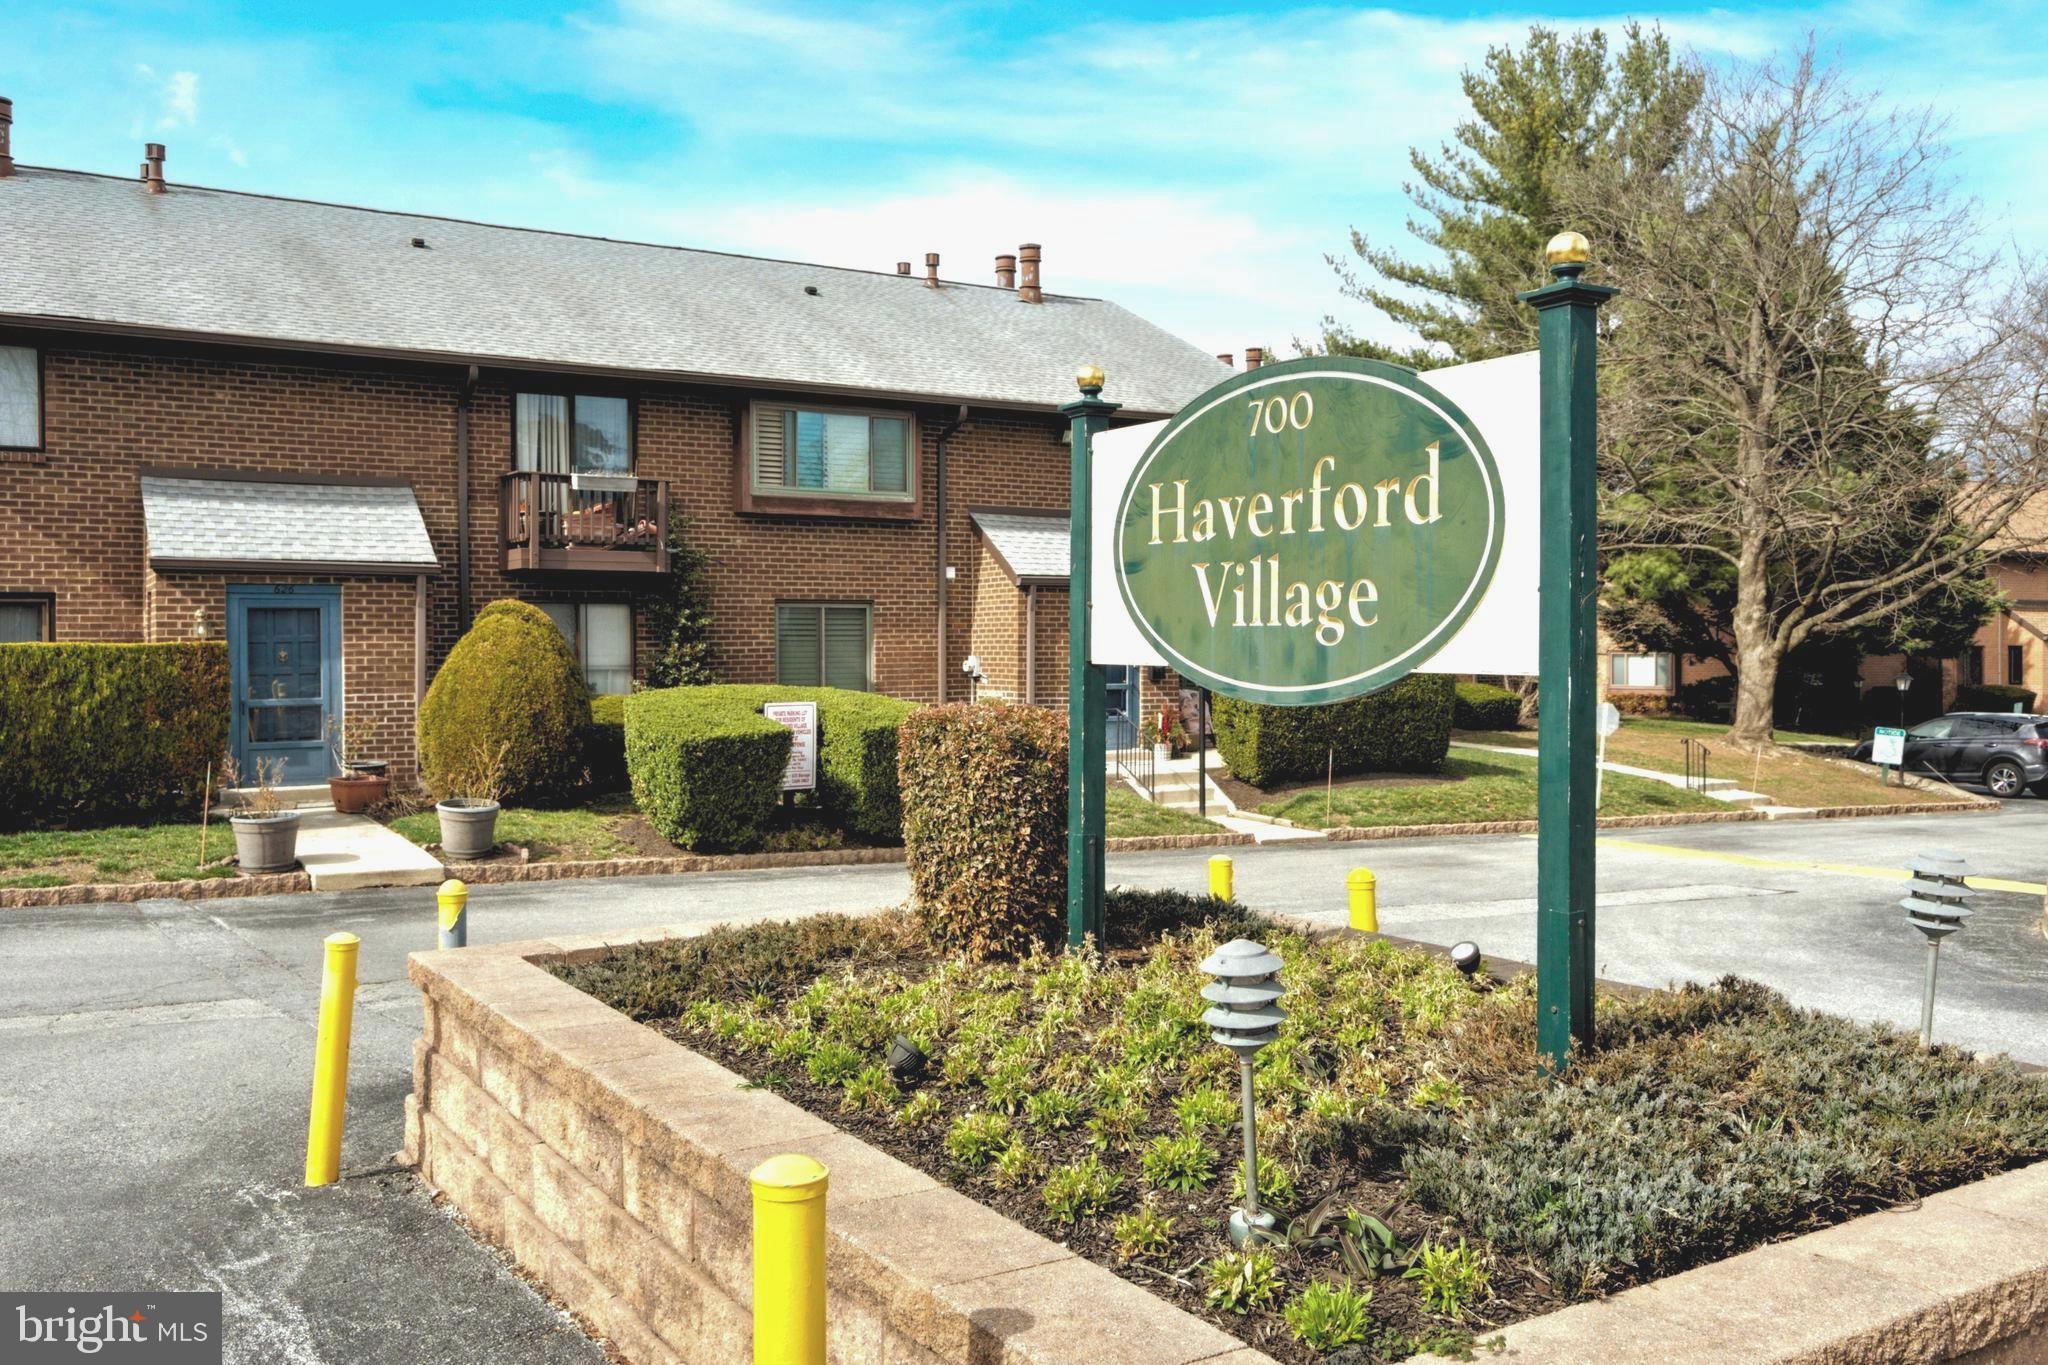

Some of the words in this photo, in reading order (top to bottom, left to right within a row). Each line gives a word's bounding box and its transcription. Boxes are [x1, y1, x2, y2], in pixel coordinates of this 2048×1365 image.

[1247, 390, 1314, 437] 700
[1147, 439, 1443, 545] Haverford
[1191, 552, 1379, 647] Village
